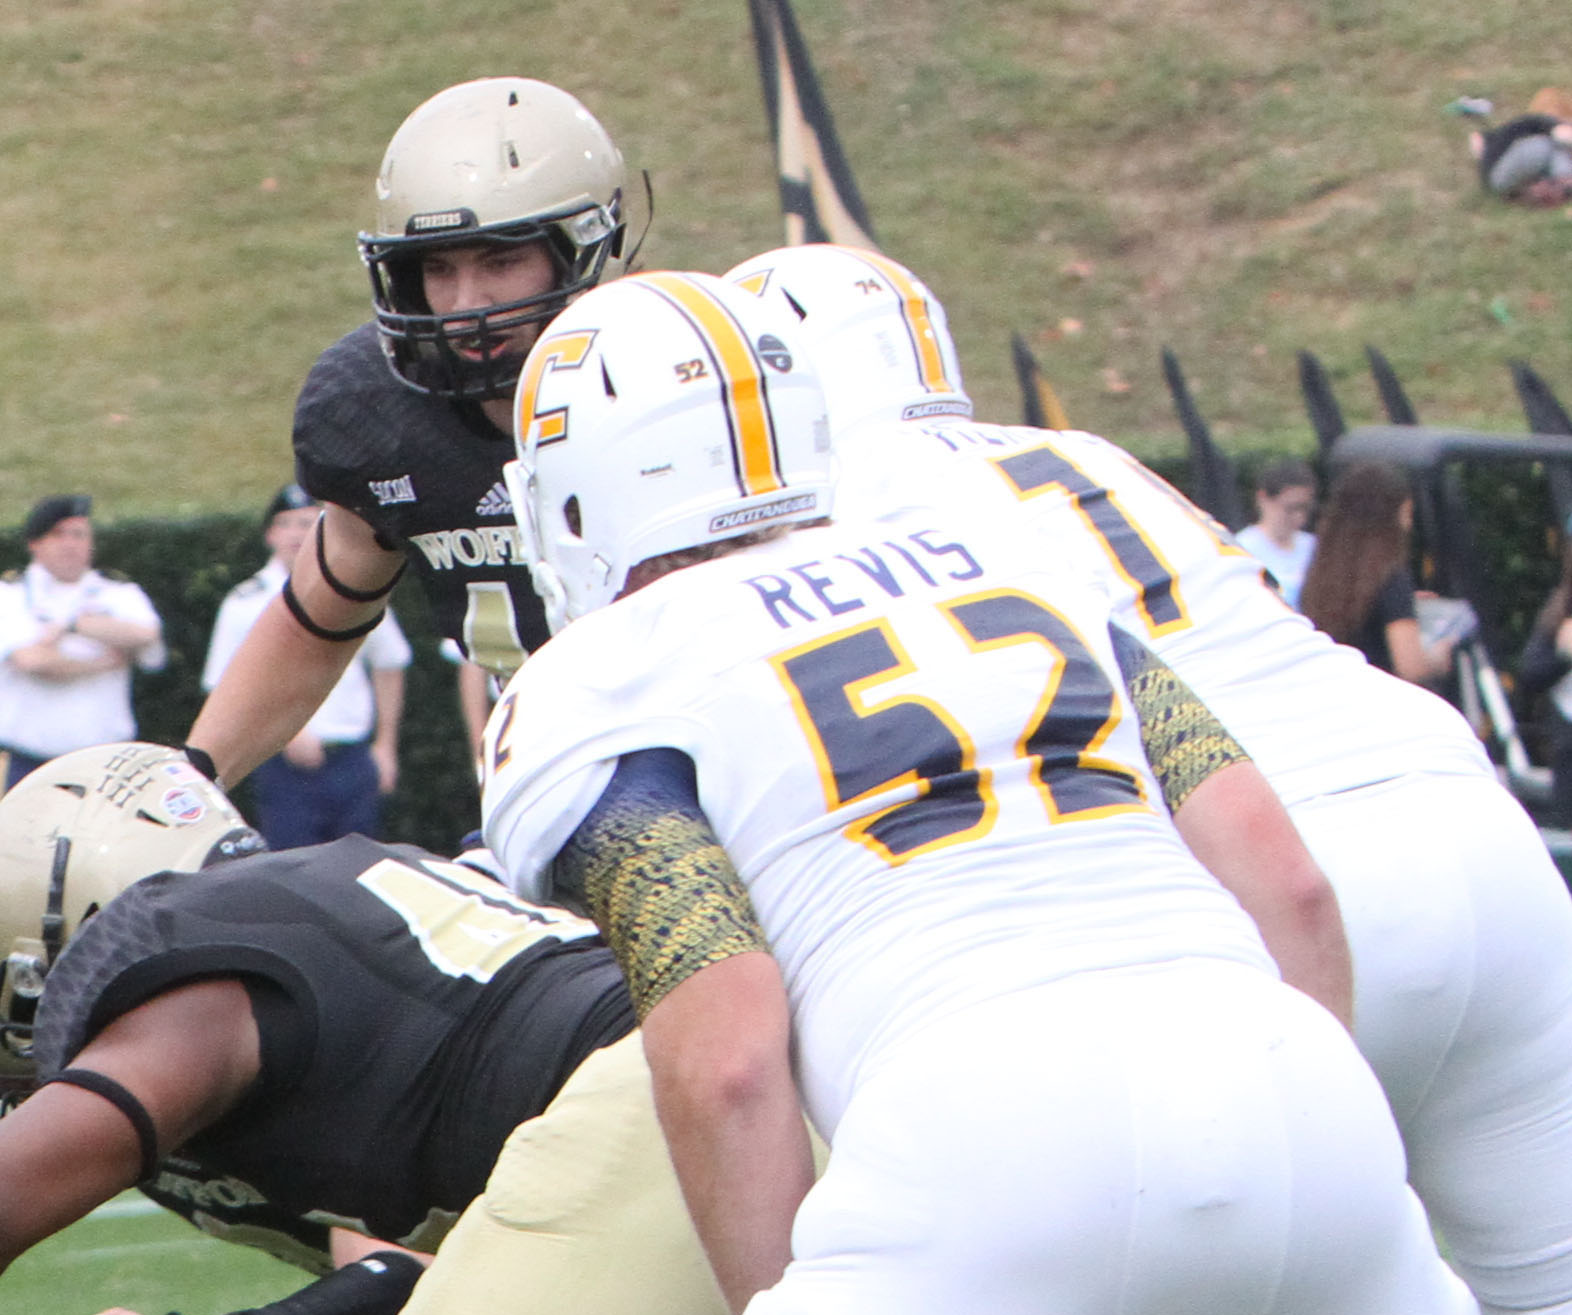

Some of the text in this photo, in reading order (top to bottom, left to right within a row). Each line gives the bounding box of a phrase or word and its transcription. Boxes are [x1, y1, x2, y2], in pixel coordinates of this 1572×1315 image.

[674, 359, 708, 384] 52
[741, 529, 984, 629] REVIS
[767, 587, 1159, 868] 52
